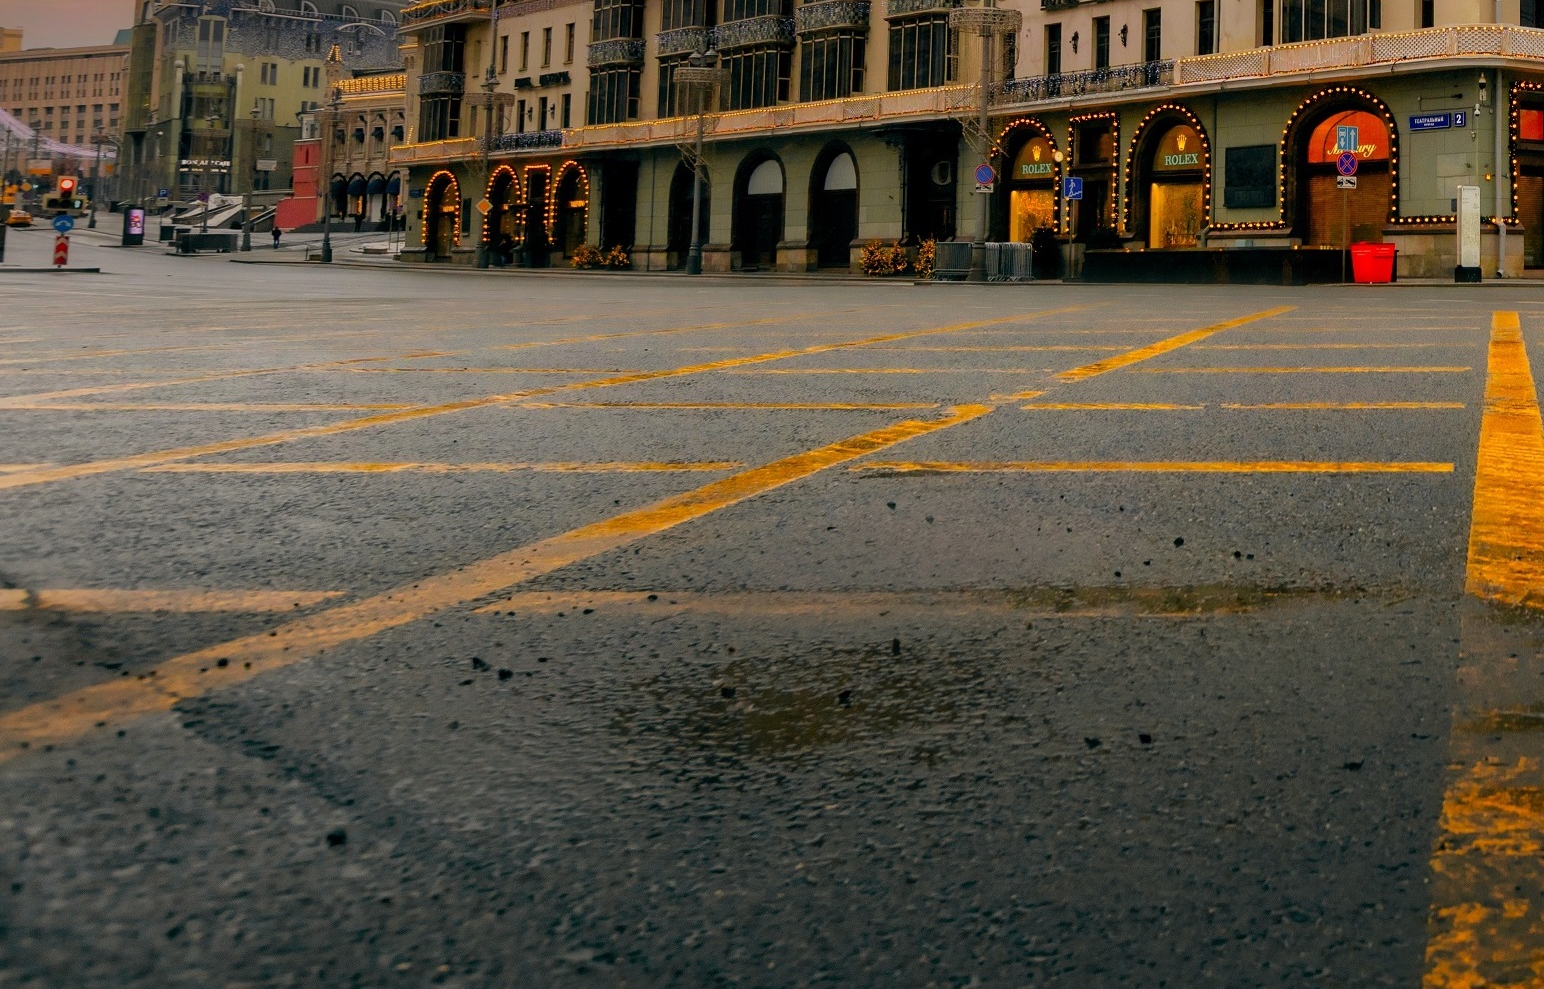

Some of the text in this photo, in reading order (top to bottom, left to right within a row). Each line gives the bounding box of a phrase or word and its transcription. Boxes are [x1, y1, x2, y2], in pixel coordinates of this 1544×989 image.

[1456, 114, 1462, 124] 2
[1164, 153, 1199, 166] ROLEX
[1022, 163, 1052, 175] ROLEX
